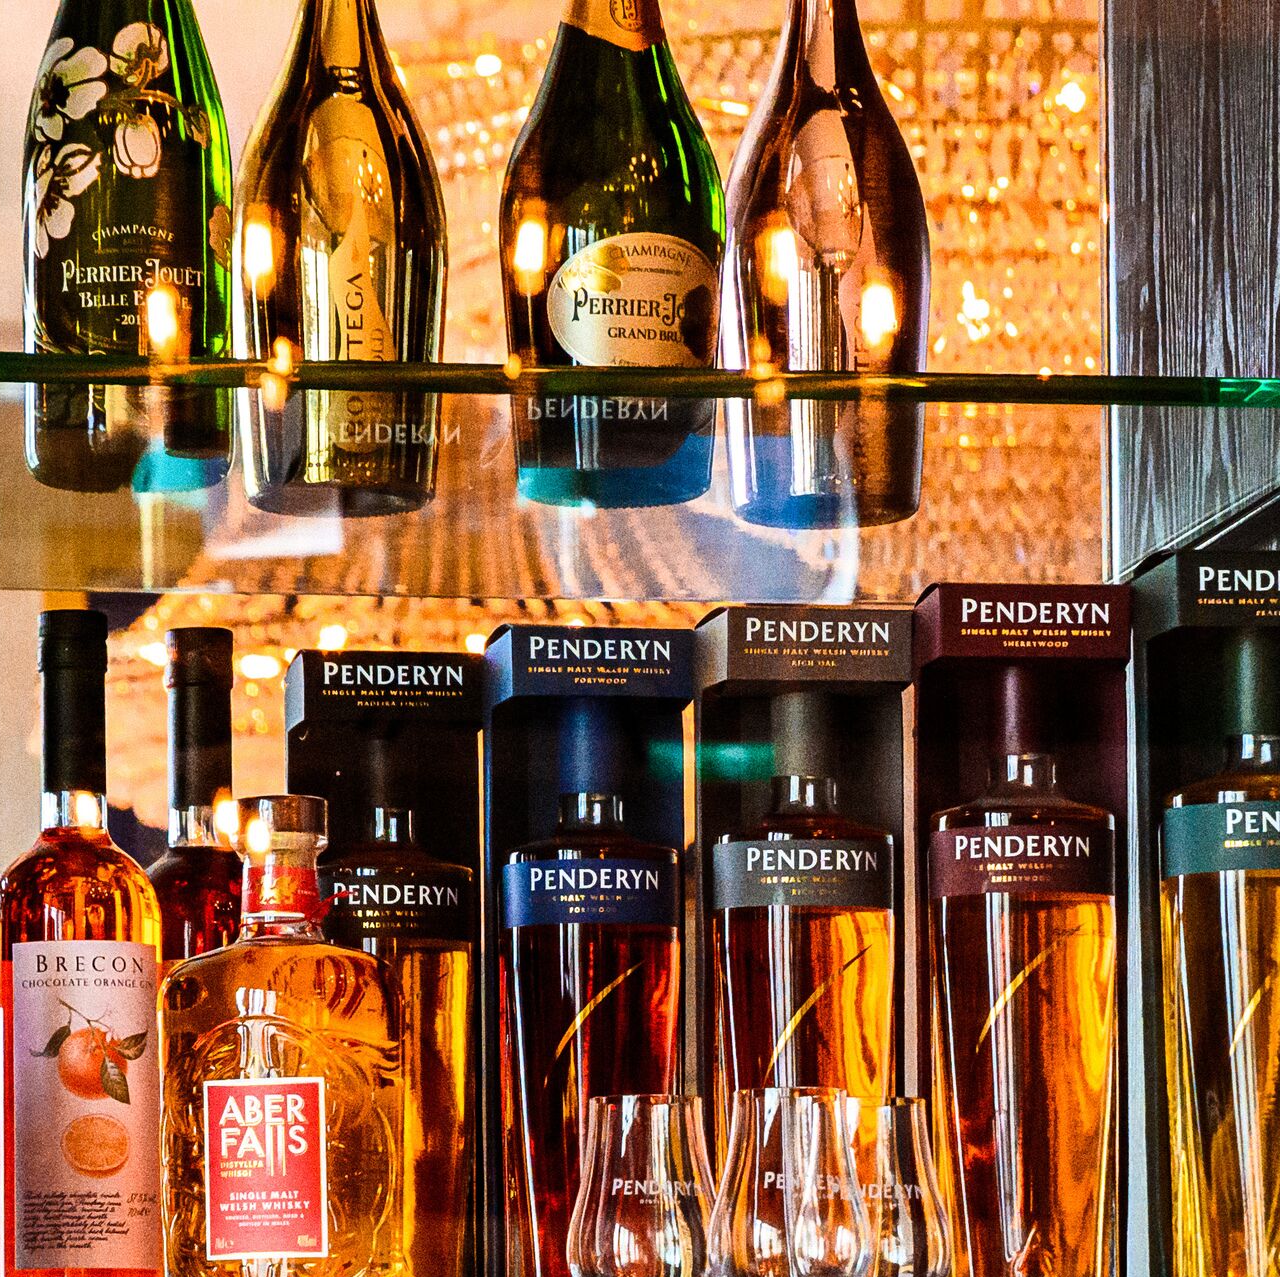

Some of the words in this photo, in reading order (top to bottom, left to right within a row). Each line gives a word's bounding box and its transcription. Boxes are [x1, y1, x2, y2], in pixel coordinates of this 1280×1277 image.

[92, 224, 176, 242] CHAMPAGNE
[609, 244, 693, 268] CHAMPAGNE
[79, 291, 129, 308] BELLE
[607, 326, 657, 341] GRAND
[659, 330, 683, 343] BRU
[961, 598, 1110, 625] PENDERYN
[746, 617, 890, 643] PENDERYN
[961, 628, 998, 636] SINGLE
[1032, 629, 1068, 637] WELSH
[529, 635, 671, 661] PENDERYN
[323, 661, 464, 687] PENDERYN
[567, 666, 593, 674] MALT
[360, 689, 386, 697] MALT
[955, 835, 1091, 861] PENDERYN
[746, 847, 878, 872] PENDERYN
[530, 867, 659, 892] PENDERYN
[333, 882, 459, 907] PENDERYN
[36, 954, 144, 974] BRECON
[21, 978, 89, 989] CHOCOLATE
[93, 977, 140, 988] ORANGE
[219, 1094, 309, 1127] ABER
[219, 1202, 257, 1212] WELSH
[262, 1200, 311, 1211] WHISKY
[230, 1191, 267, 1201] SINGLE
[270, 1190, 299, 1200] MALT
